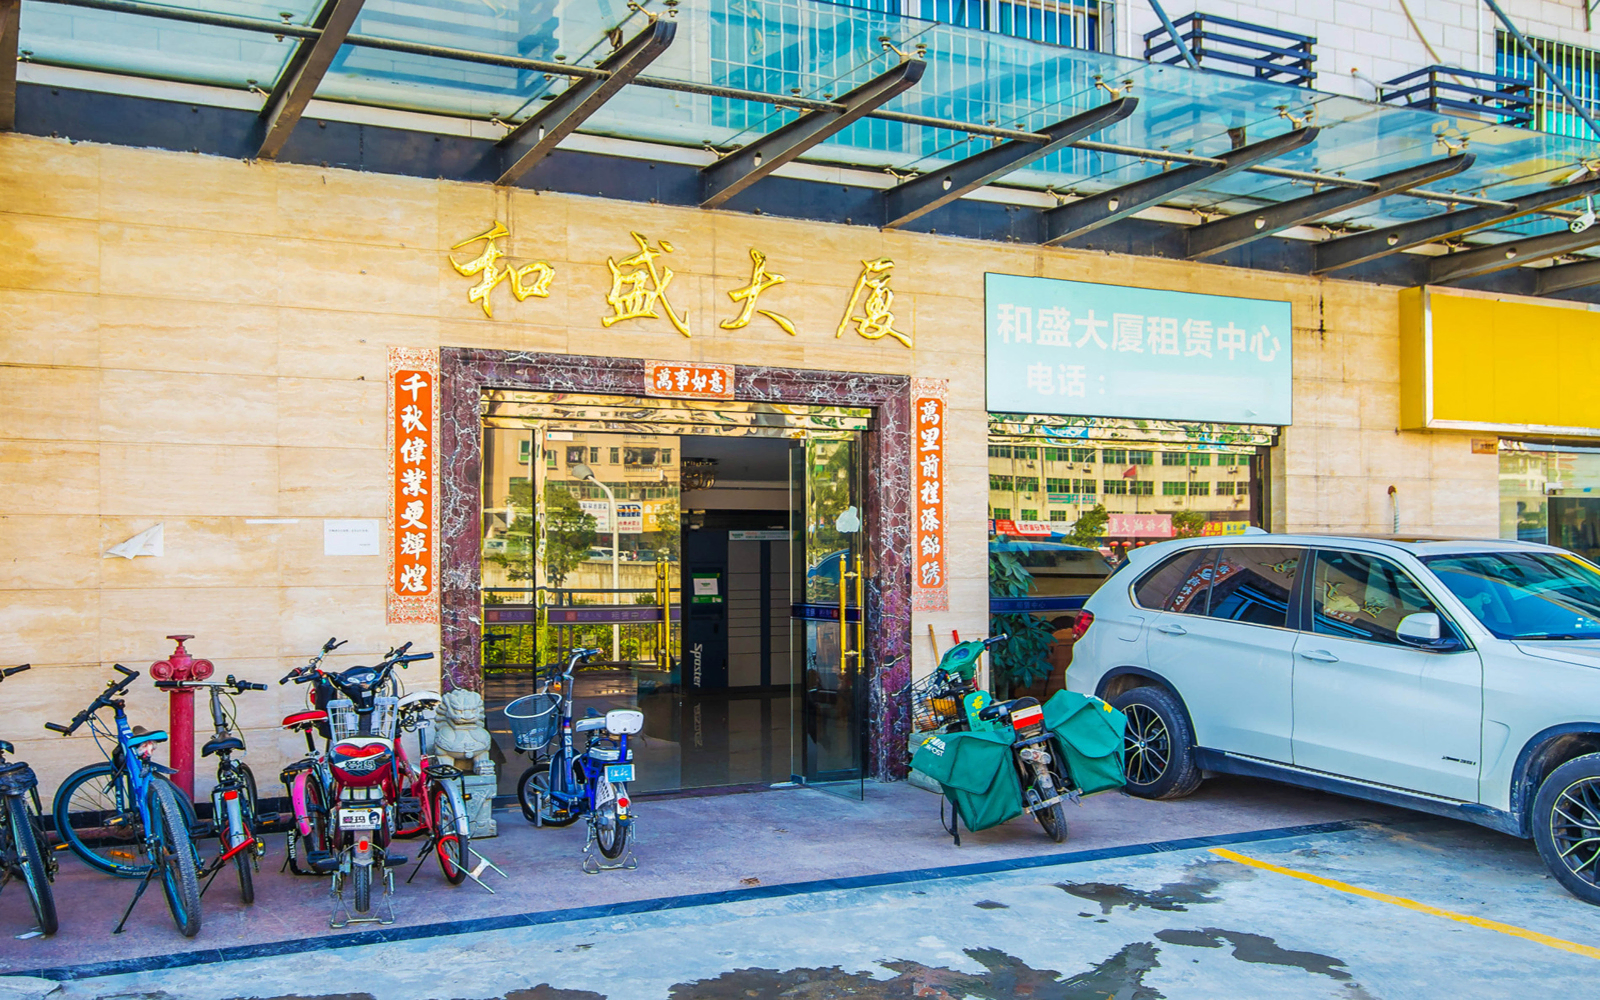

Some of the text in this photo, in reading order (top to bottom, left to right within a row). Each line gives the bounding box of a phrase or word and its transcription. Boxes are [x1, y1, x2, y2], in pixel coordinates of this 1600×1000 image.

[449, 220, 912, 348] 和盛大厦
[996, 303, 1281, 362] 和盛大厦租赁中心
[656, 367, 723, 393] 萬事如意
[400, 372, 428, 593] 千秋偉業更輝煌
